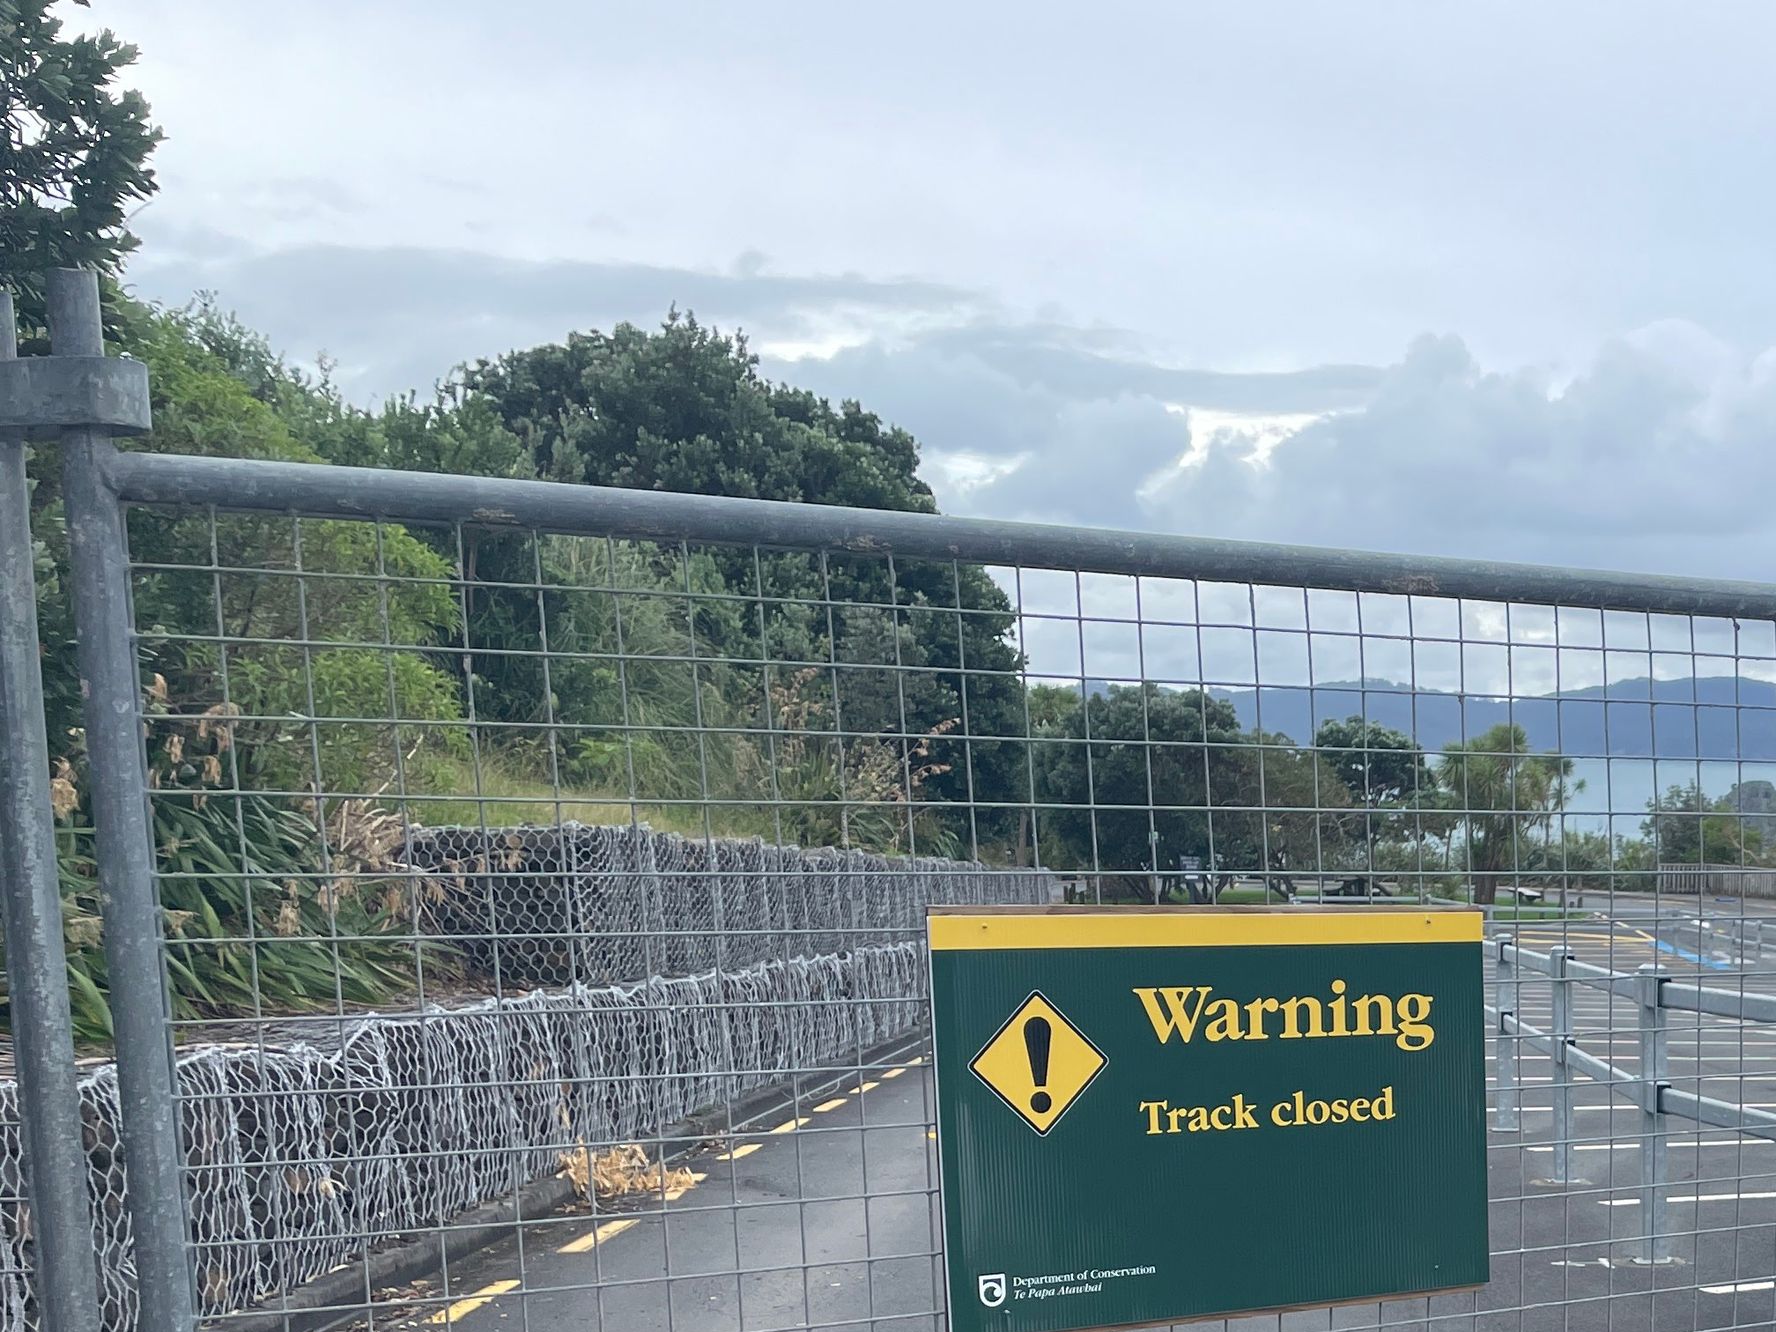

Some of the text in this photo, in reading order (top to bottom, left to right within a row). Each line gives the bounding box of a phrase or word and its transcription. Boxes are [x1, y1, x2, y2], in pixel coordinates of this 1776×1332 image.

[1133, 979, 1435, 1052] Warning
[1140, 1087, 1396, 1135] Track closed
[1013, 1265, 1156, 1287] Department of Conservation
[1014, 1282, 1102, 1299] Te Papa Atawhai
